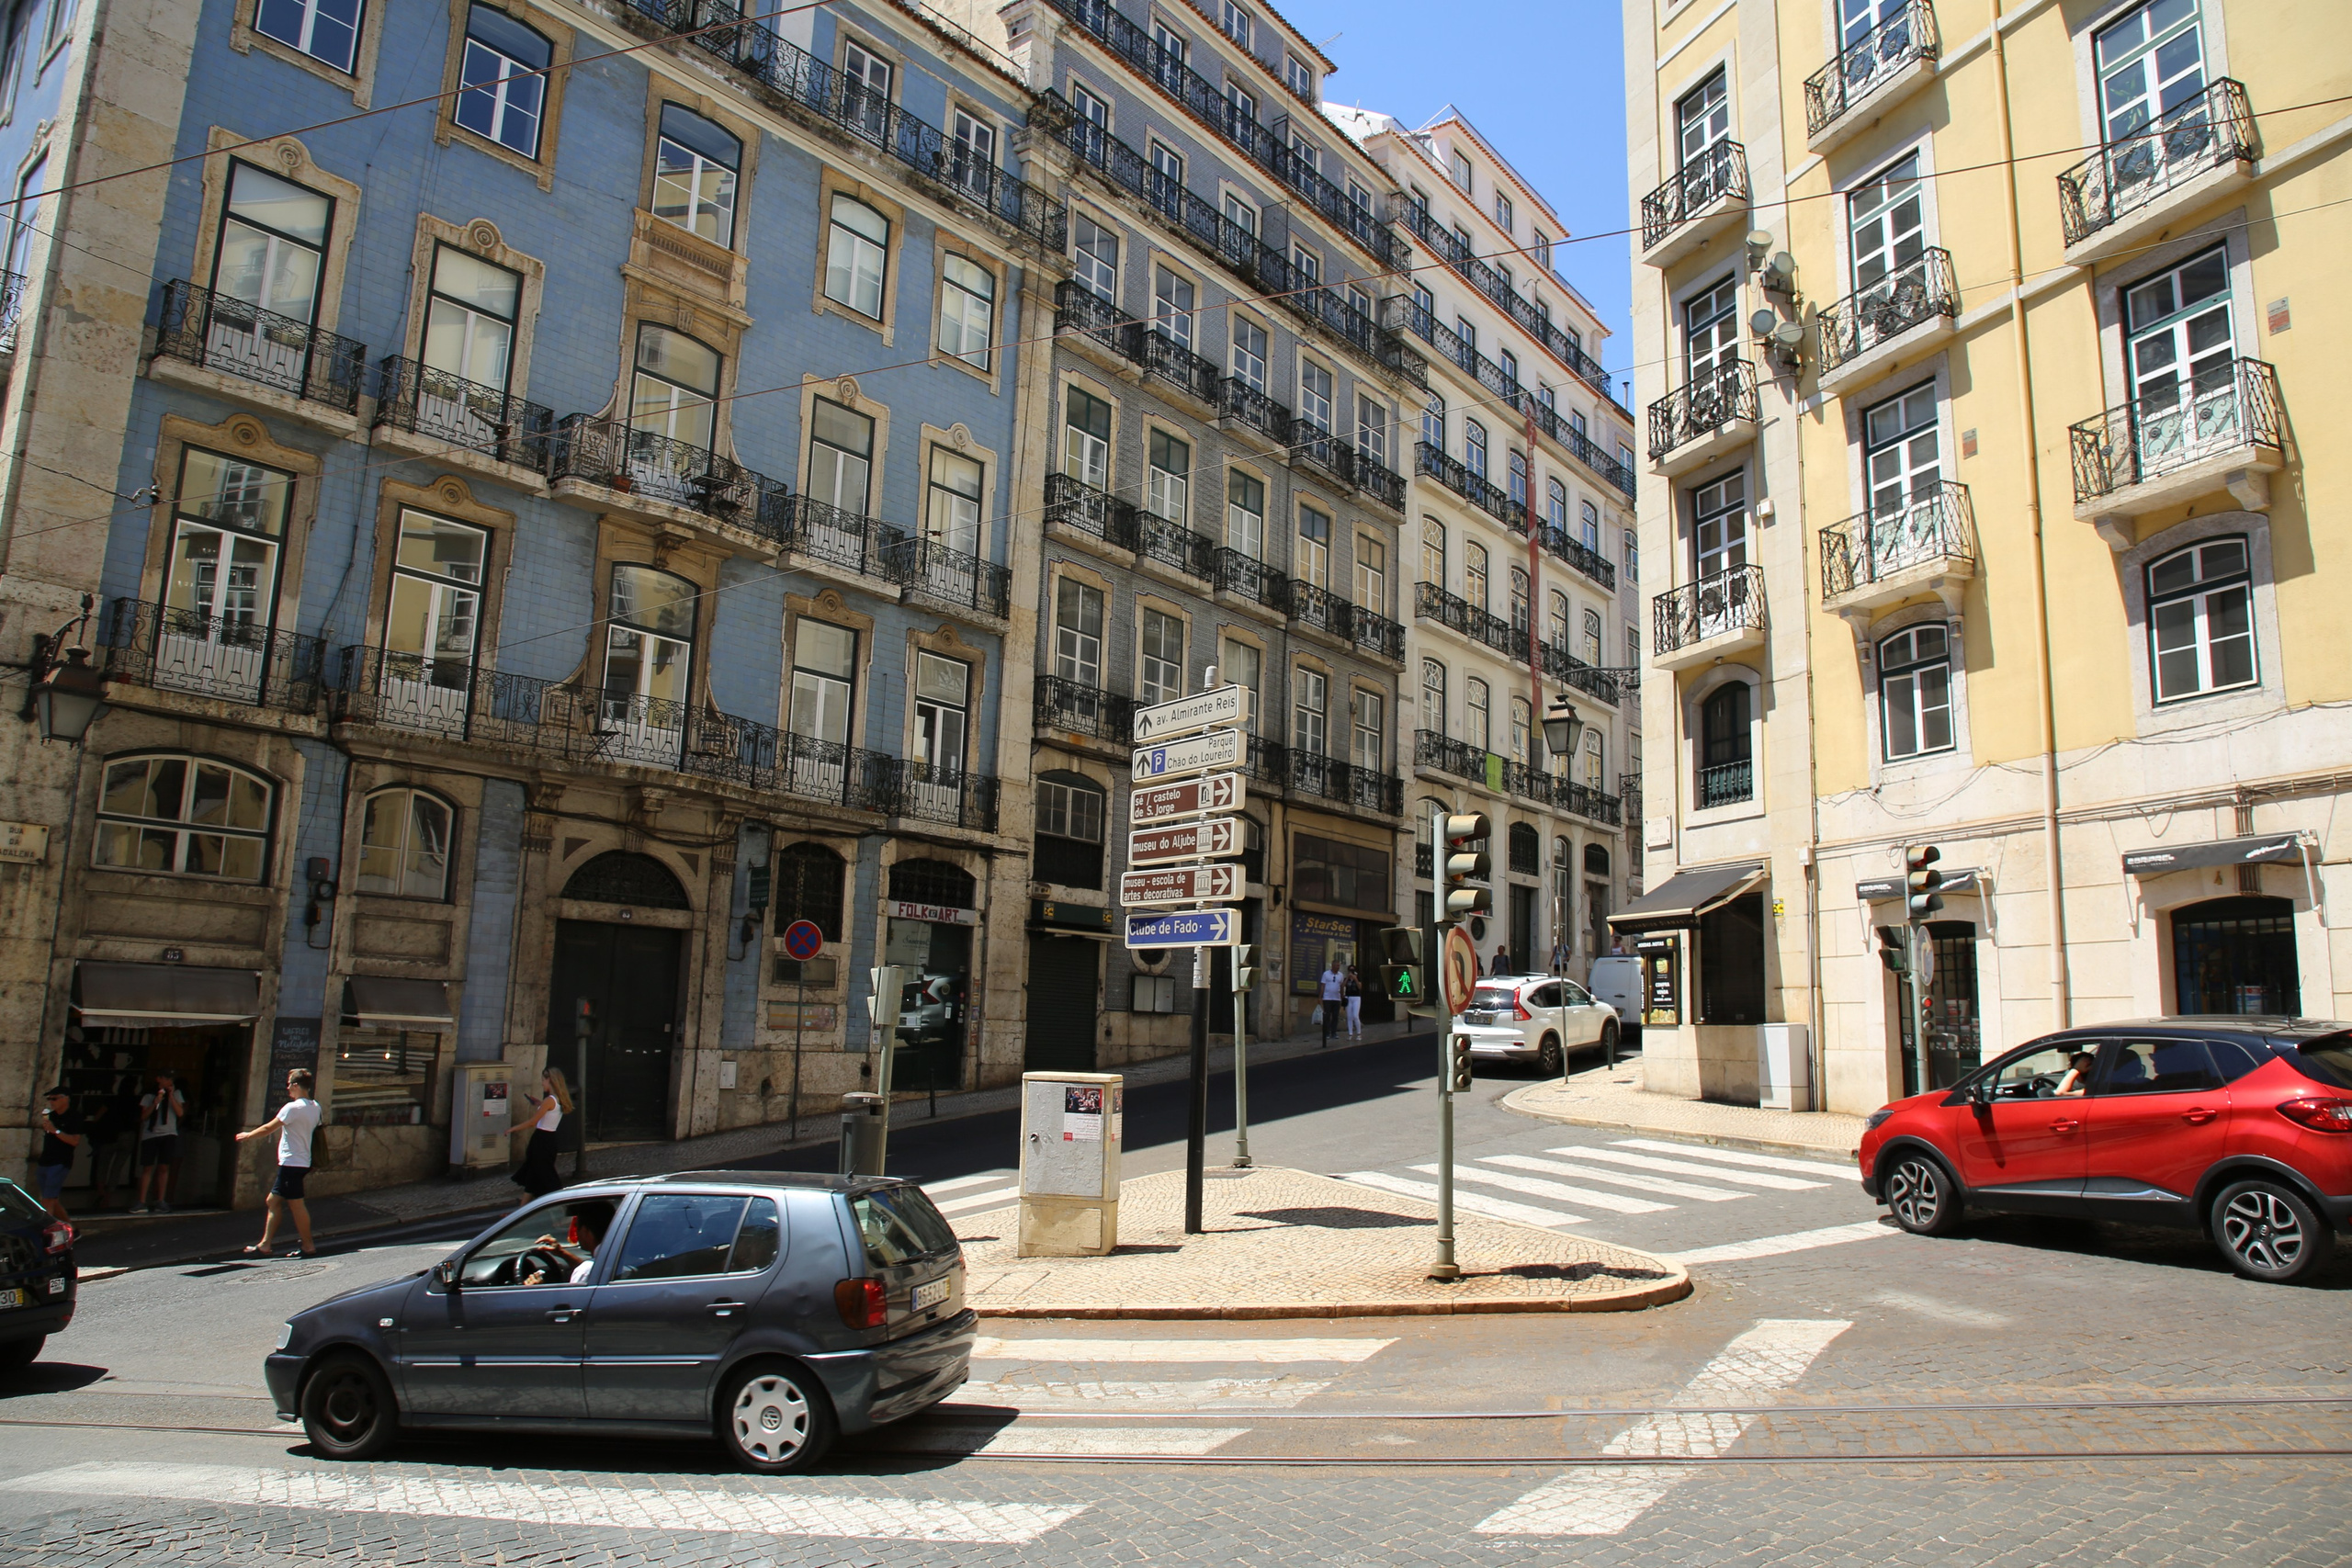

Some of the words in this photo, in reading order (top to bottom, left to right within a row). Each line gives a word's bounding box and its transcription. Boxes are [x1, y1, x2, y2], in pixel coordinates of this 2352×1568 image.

[1157, 715, 1168, 726] av.
[1170, 703, 1213, 723] Almirante
[1216, 695, 1235, 710] Reis
[1208, 737, 1233, 750] Parque
[1167, 755, 1186, 769] Chão
[1188, 753, 1198, 765] do
[1201, 749, 1233, 763] Loureiro
[1135, 795, 1145, 807] sé
[1153, 789, 1181, 804] castelo
[1135, 806, 1145, 818] de
[1147, 805, 1154, 816] S.
[1155, 802, 1174, 818] Jorge
[1133, 840, 1157, 853] museu
[1159, 837, 1170, 850] do
[1172, 833, 1196, 850] Aljube
[1125, 875, 1146, 888] museu
[1152, 873, 1174, 886] escola
[1177, 873, 1186, 884] de
[1124, 888, 1140, 901] artes
[1143, 886, 1183, 900] decorativas
[899, 903, 929, 919] FOLK
[938, 908, 959, 922] ART
[1129, 921, 1156, 937] Clube
[1159, 920, 1170, 935] de
[1173, 919, 1198, 935] Fado
[1306, 917, 1351, 932] StarSec
[0, 1291, 16, 1303] 30
